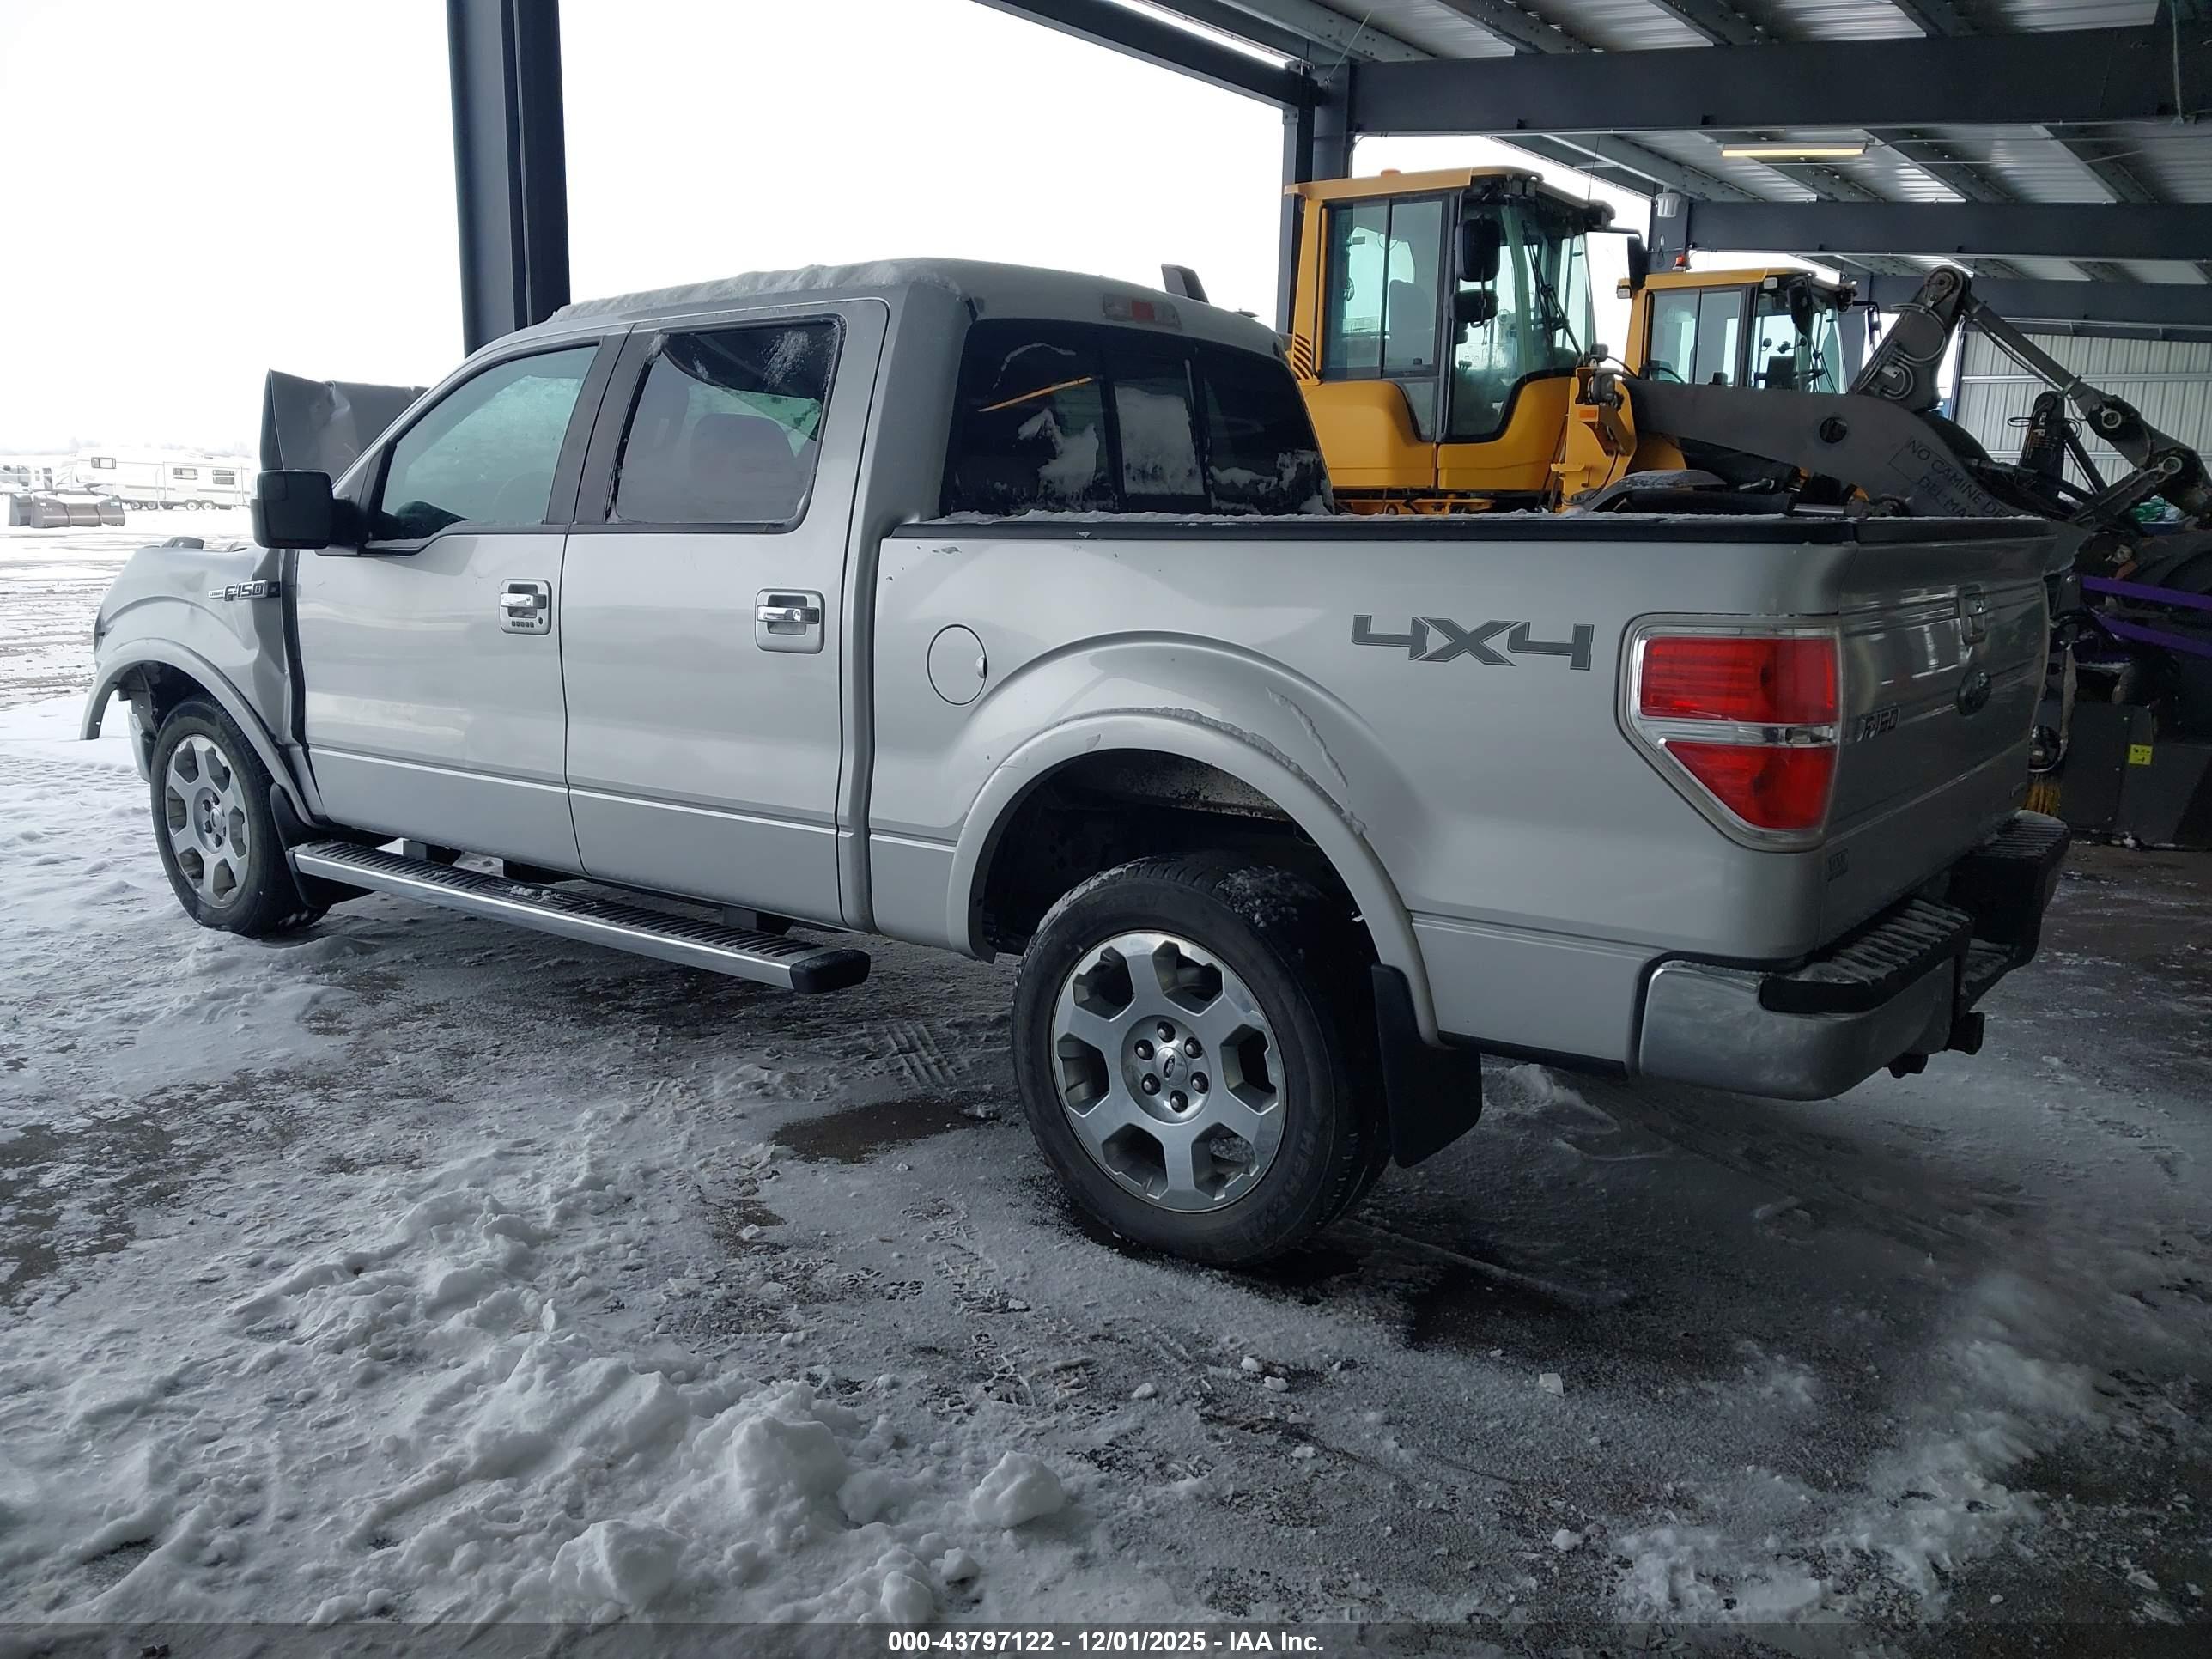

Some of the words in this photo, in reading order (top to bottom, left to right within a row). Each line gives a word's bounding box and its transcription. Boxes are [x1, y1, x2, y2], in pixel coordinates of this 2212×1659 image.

[1909, 439, 1931, 461] NO
[1931, 459, 1985, 504] CAMINE
[223, 580, 266, 602] F-150
